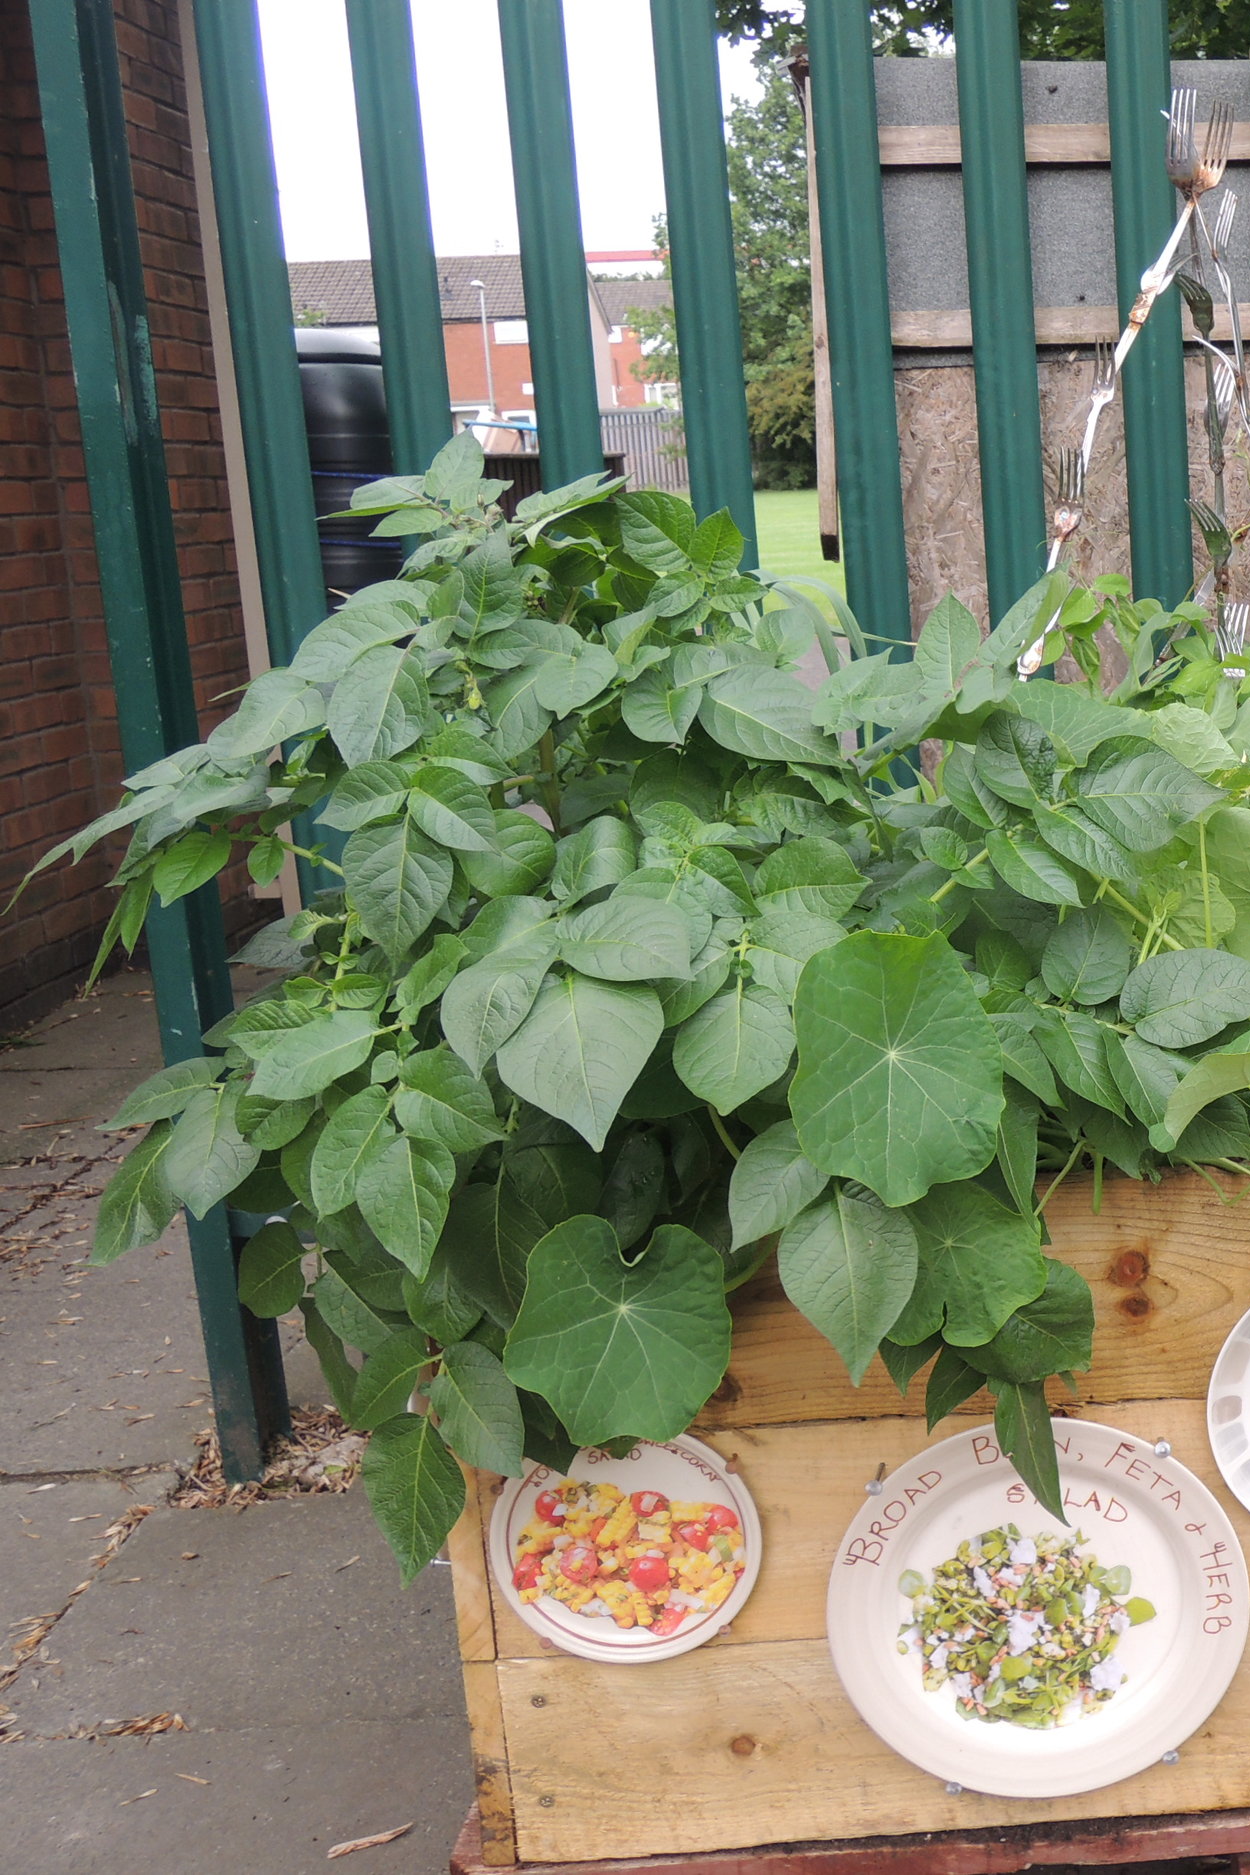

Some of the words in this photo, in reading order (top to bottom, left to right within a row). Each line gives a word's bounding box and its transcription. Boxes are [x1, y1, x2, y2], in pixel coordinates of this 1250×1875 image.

[843, 1470, 943, 1566] BROAD
[1105, 1442, 1182, 1511] FETA
[1184, 1522, 1207, 1536] &
[1200, 1541, 1234, 1635] HERB
[1006, 1483, 1128, 1523] SLAD
